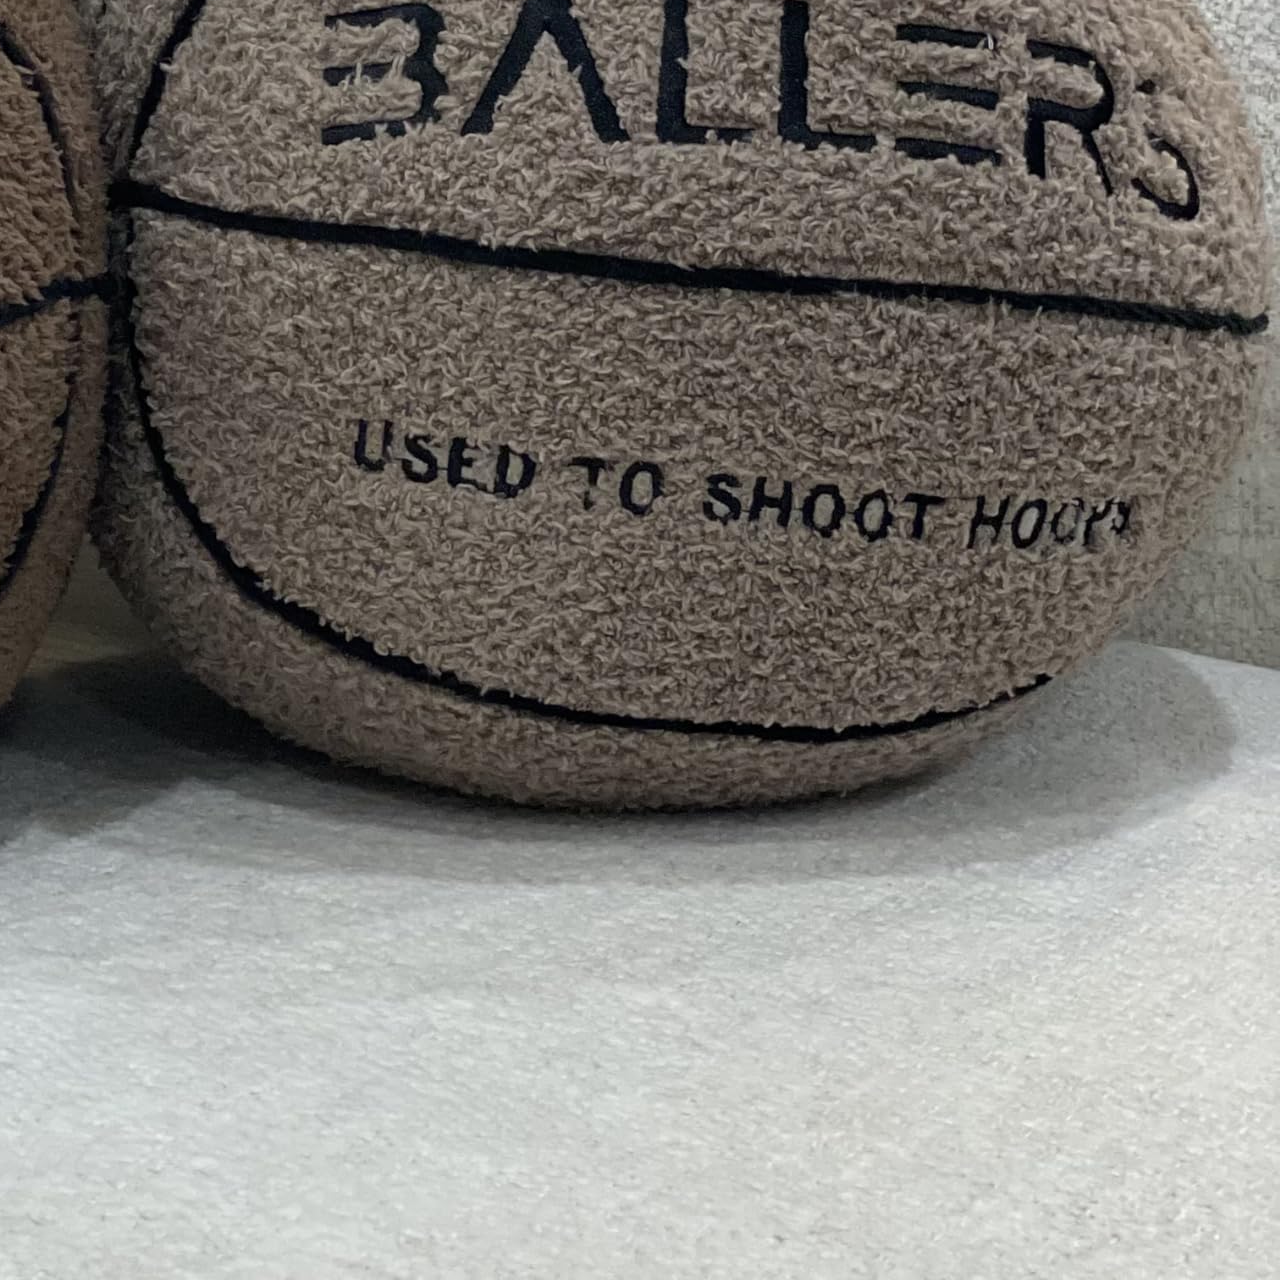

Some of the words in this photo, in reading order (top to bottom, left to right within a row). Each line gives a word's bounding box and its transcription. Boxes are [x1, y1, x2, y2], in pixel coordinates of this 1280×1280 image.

[353, 420, 536, 498] USED
[572, 456, 664, 514] TO
[703, 474, 944, 542] SHOOT
[967, 494, 1131, 549] HOOPS
